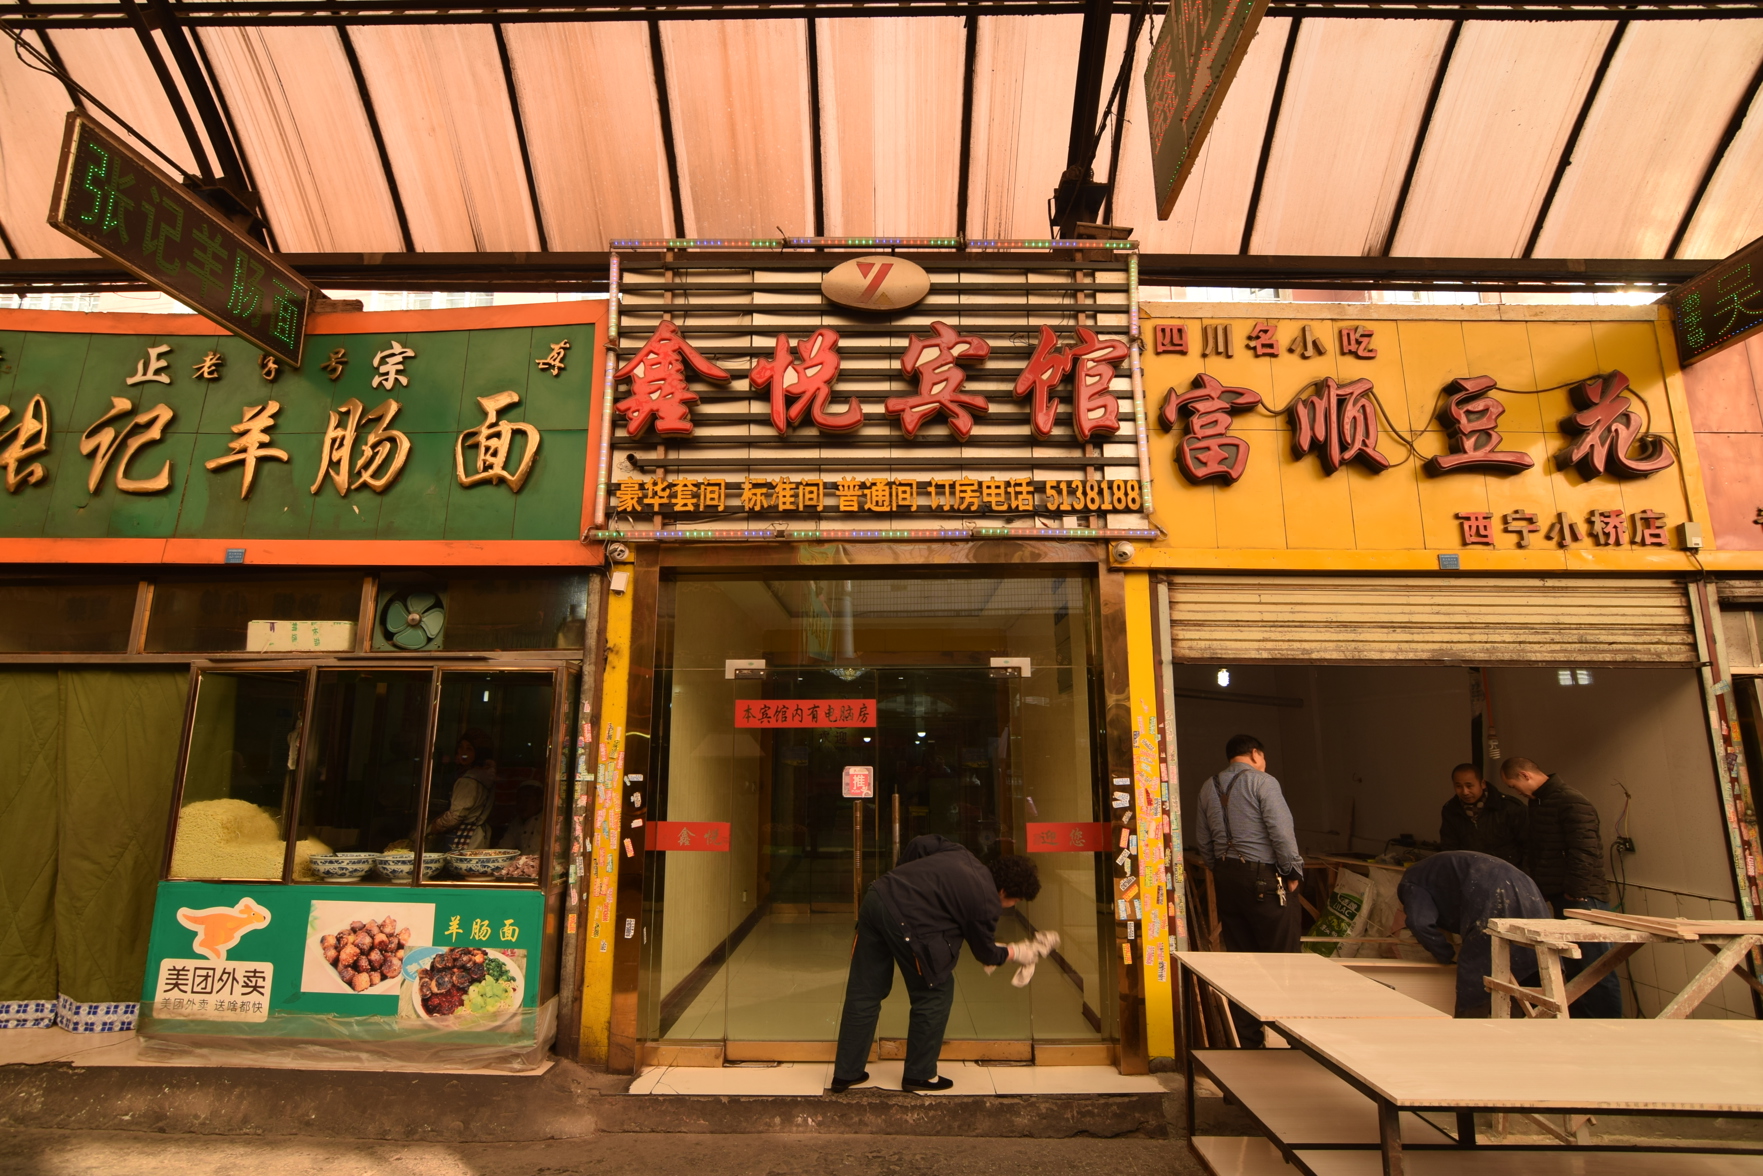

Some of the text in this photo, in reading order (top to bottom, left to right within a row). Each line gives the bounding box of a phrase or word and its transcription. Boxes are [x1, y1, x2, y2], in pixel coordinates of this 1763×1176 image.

[81, 143, 299, 350] 张记羊肠面
[1154, 322, 1378, 359] 四川名小吃
[613, 319, 1130, 443] 鑫悦宾馆
[1158, 369, 1676, 487] 富顺豆花
[616, 476, 1141, 512] 豪华套间 标准间 普通间 订房电话 5138188
[1456, 509, 1669, 547] 西宁小桥店
[742, 703, 870, 724] 本宾馆内有电脑房
[852, 774, 866, 790] 推
[677, 826, 723, 847] 鑫悦
[444, 915, 520, 943] 羊肠面
[163, 965, 267, 997] 美团外卖
[160, 997, 263, 1014] 美团外卖 送啥都快
